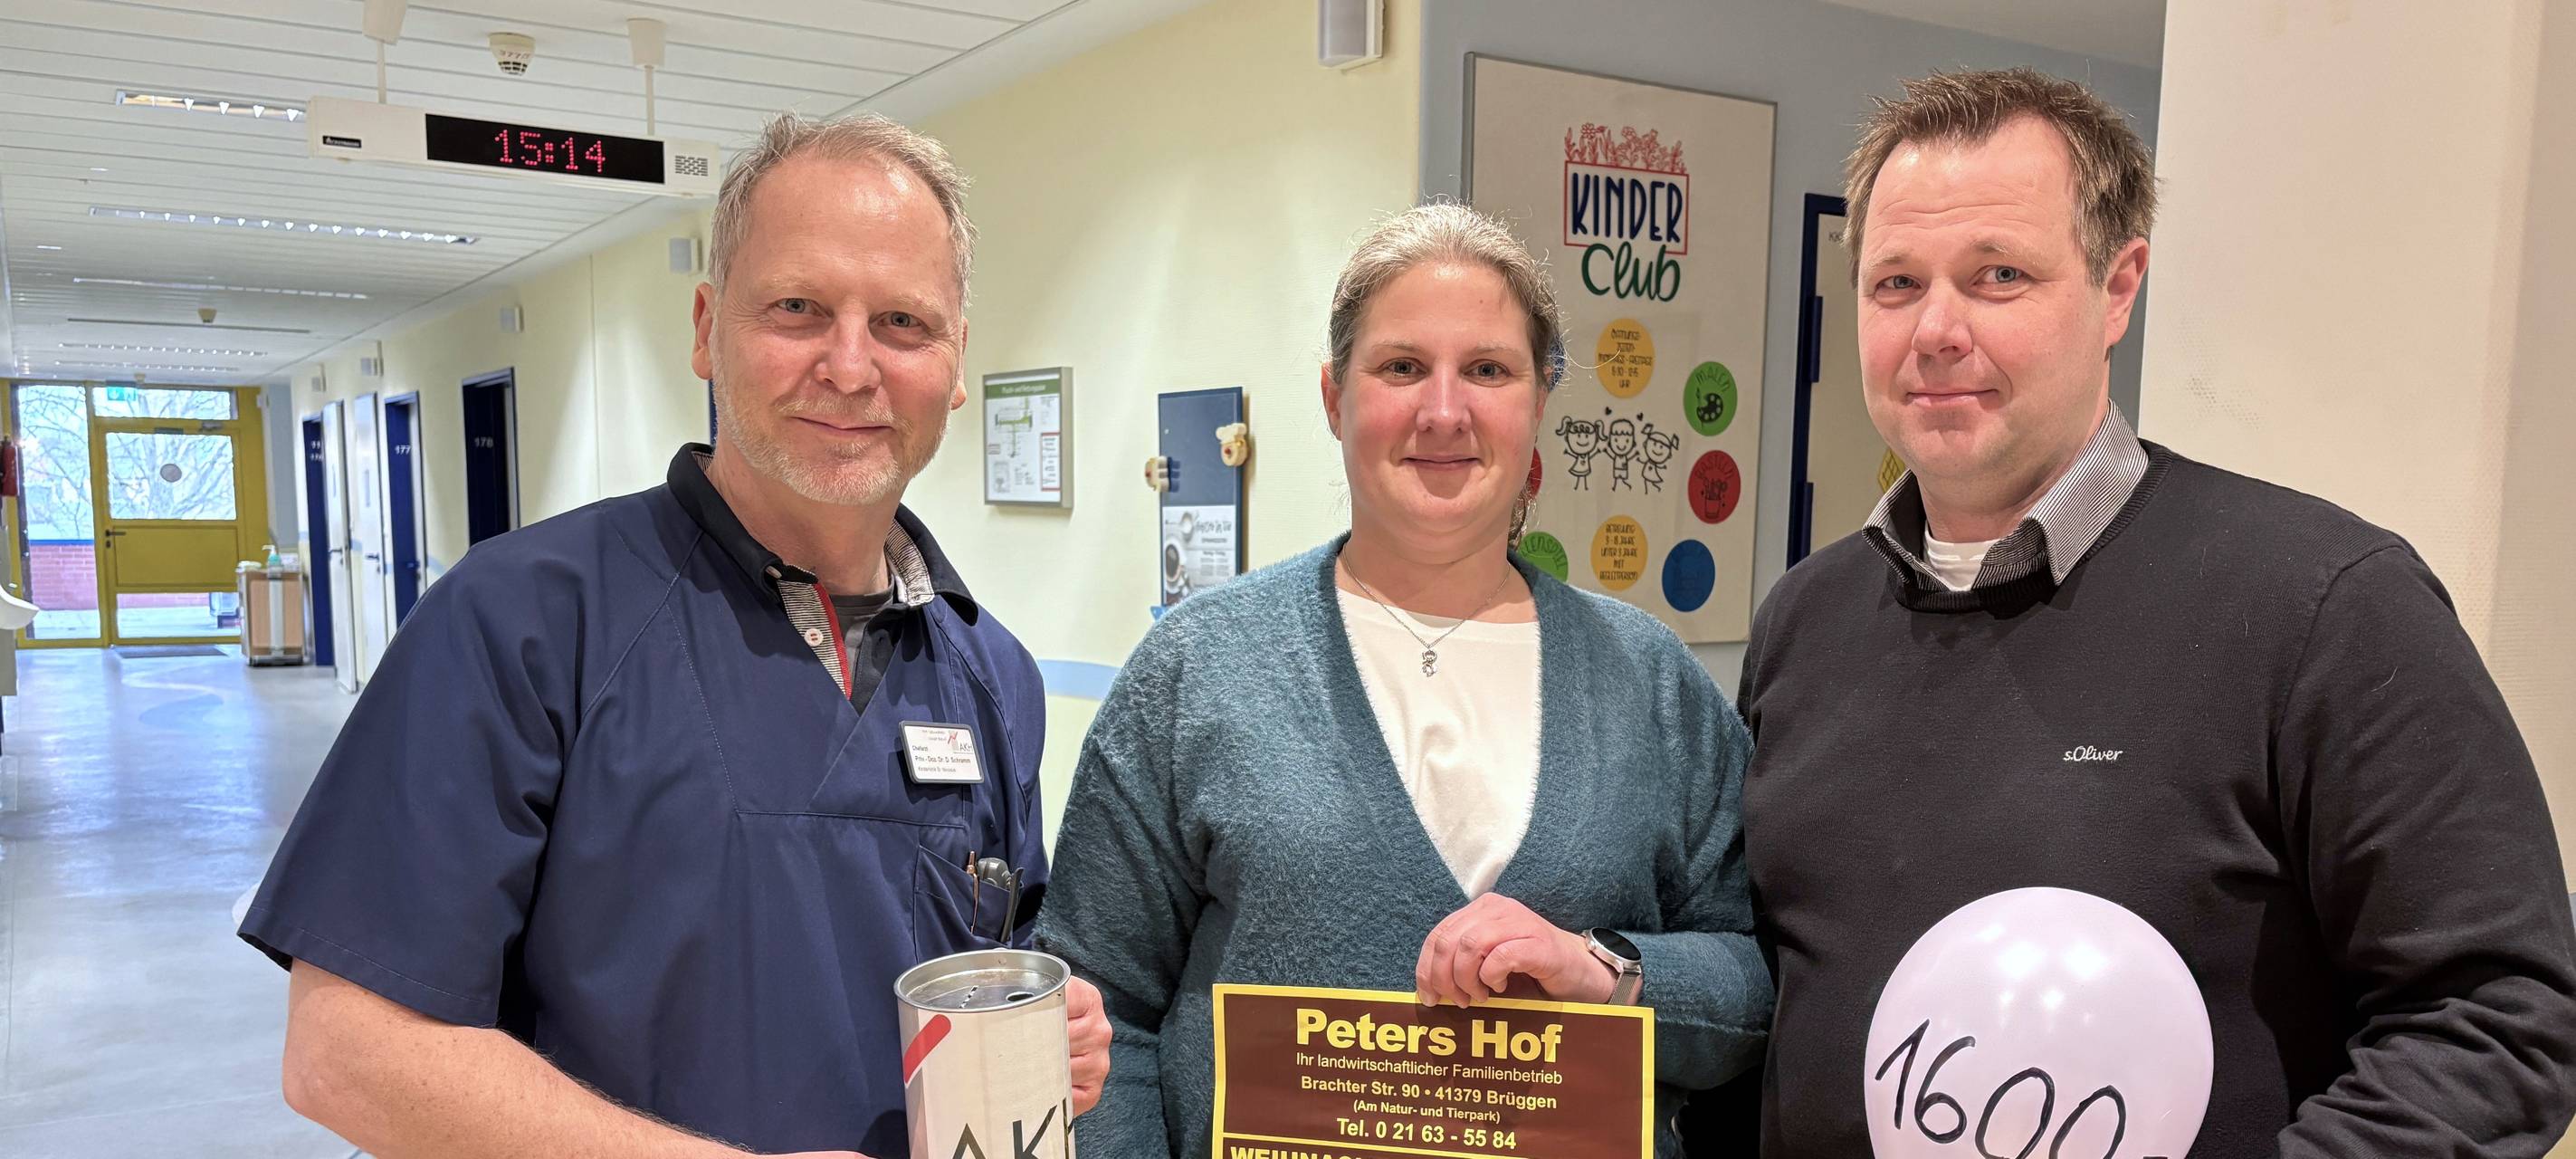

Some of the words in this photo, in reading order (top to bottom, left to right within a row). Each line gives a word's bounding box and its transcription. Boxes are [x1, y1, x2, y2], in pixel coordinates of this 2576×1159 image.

[494, 129, 606, 173] 15:14
[1571, 172, 1683, 243] KINDER
[1581, 241, 1681, 302] Club
[2063, 745, 2123, 761] s.Oliver
[1296, 1008, 1457, 1056] Peters
[1471, 1019, 1563, 1063] Hof
[1296, 1052, 1314, 1066] Ihr
[1318, 1054, 1448, 1077] landwirtschaftlicher
[1453, 1064, 1563, 1084] Familienbetrieb
[1301, 1076, 1367, 1094] Brachter
[1371, 1081, 1397, 1096] Str.
[1401, 1084, 1420, 1097] 90
[1435, 1086, 1482, 1103] 41379
[1487, 1089, 1557, 1111] Brüggen
[1353, 1099, 1378, 1113] (Am
[1380, 1102, 1417, 1115] Natur-
[1420, 1106, 1443, 1117] und
[1446, 1107, 1501, 1124] Tierpark)
[1336, 1117, 1369, 1137] Tel.
[1375, 1121, 1388, 1138] 0
[1392, 1123, 1414, 1141] 21
[1421, 1125, 1445, 1144] 63
[1463, 1128, 1487, 1147] 55
[1492, 1130, 1516, 1150] 84
